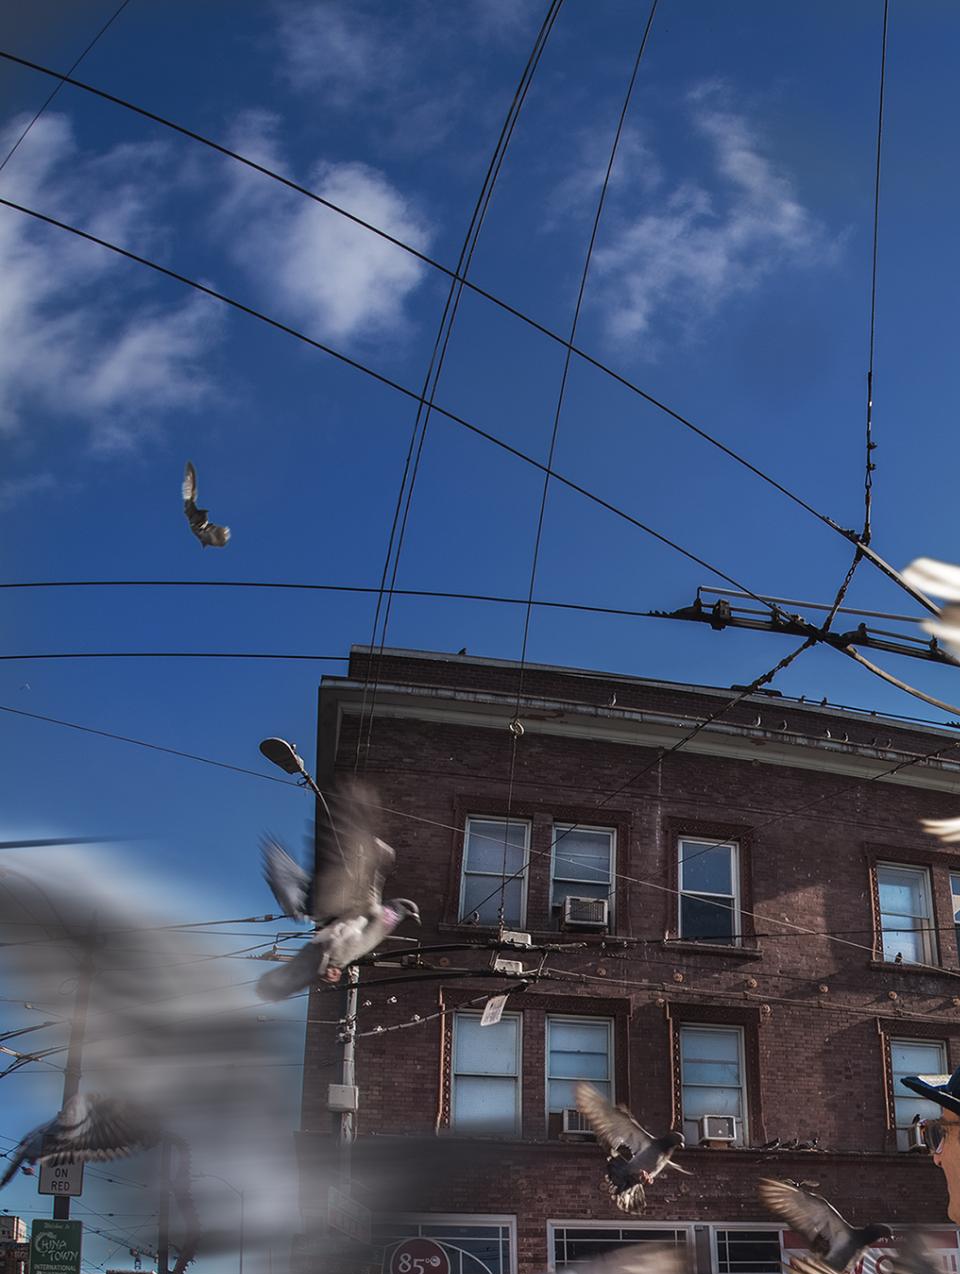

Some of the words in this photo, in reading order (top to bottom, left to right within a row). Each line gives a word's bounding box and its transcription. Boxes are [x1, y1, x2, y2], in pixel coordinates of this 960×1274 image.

[55, 1168, 68, 1178] ON
[51, 1181, 70, 1191] RED
[34, 1231, 67, 1254] CHINA
[48, 1250, 79, 1261] TOWN
